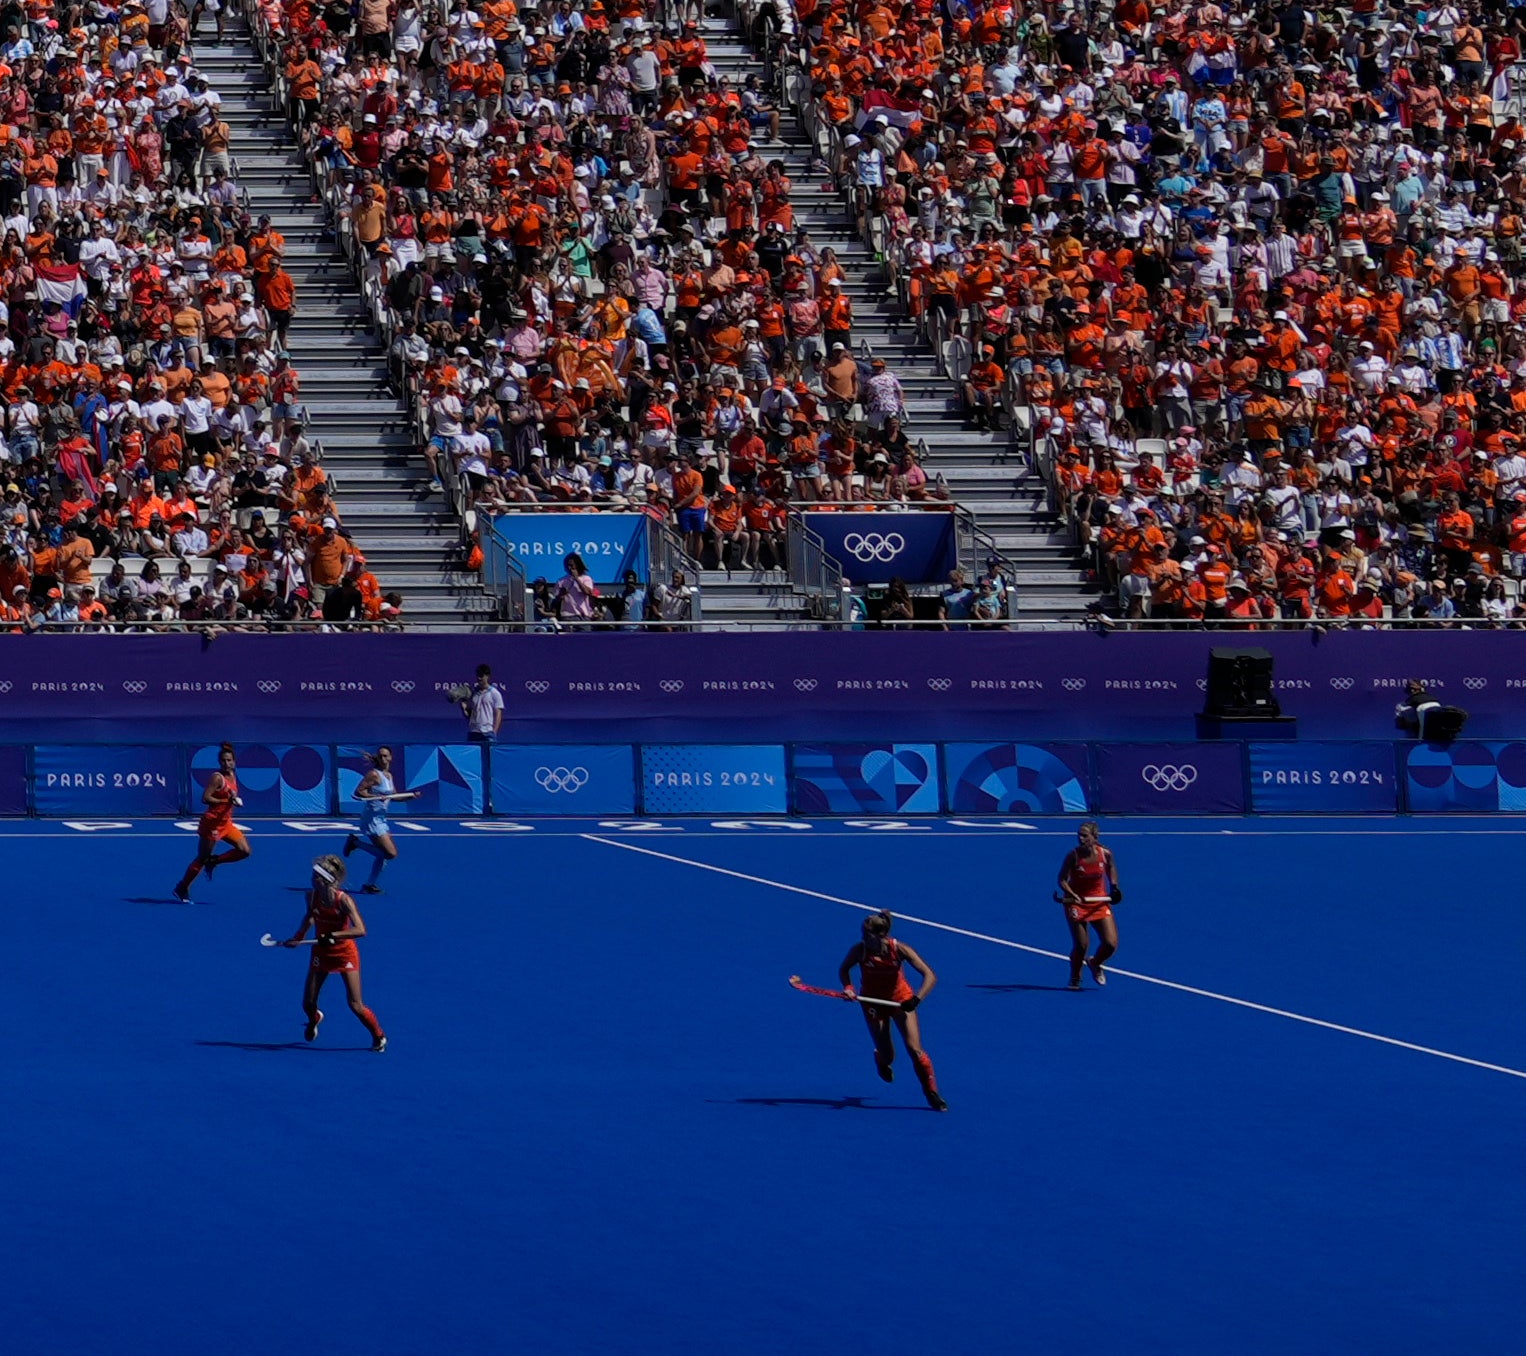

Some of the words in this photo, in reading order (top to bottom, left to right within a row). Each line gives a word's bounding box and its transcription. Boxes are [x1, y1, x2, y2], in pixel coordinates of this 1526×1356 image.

[572, 542, 625, 556] 2024
[32, 683, 67, 691] PARIS
[72, 682, 103, 691] 2024
[167, 683, 201, 691] PARIS
[206, 682, 238, 691] 2024
[301, 682, 335, 690] PARIS
[340, 682, 372, 690] 2024
[569, 683, 604, 691] PARIS
[609, 682, 640, 691] 2024
[703, 681, 738, 689] PARIS
[742, 681, 774, 689] 2024
[837, 681, 872, 689] PARIS
[877, 680, 908, 689] 2024
[971, 680, 1006, 688] PARIS
[1011, 681, 1042, 689] 2024
[1105, 680, 1141, 689] PARIS
[1145, 681, 1177, 689] 2024
[1279, 680, 1310, 688] 2024
[48, 773, 105, 787] PARIS
[114, 773, 166, 787] 2024
[655, 772, 712, 786] PARIS
[721, 772, 774, 786] 2024
[1263, 771, 1321, 784] PARIS
[1330, 771, 1382, 784] 2024
